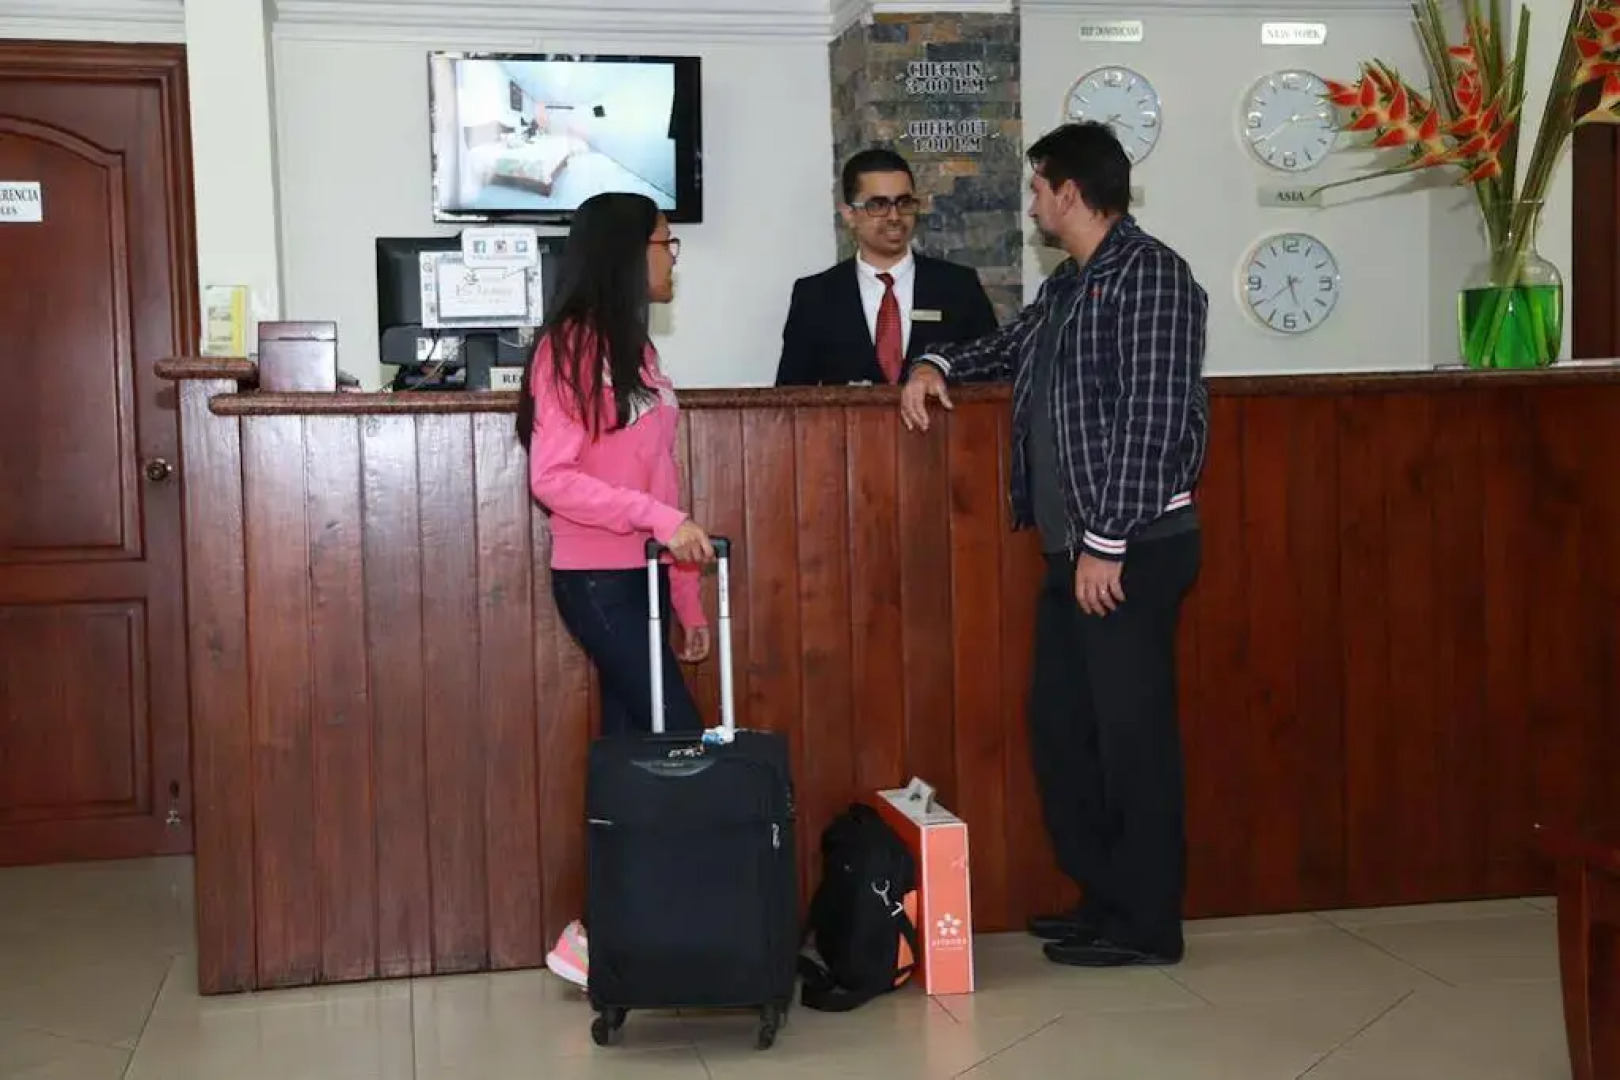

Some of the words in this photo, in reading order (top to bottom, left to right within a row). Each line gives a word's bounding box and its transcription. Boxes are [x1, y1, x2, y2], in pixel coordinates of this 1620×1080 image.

[1293, 29, 1321, 39] YORK
[908, 61, 962, 77] CHECK
[963, 61, 983, 77] IN
[909, 120, 955, 137] CHECK
[957, 119, 988, 137] OUT
[1277, 191, 1305, 201] ASIA
[1282, 239, 1299, 253] 12
[1248, 276, 1262, 291] 9
[1319, 276, 1333, 291] 3
[1283, 315, 1296, 329] 6
